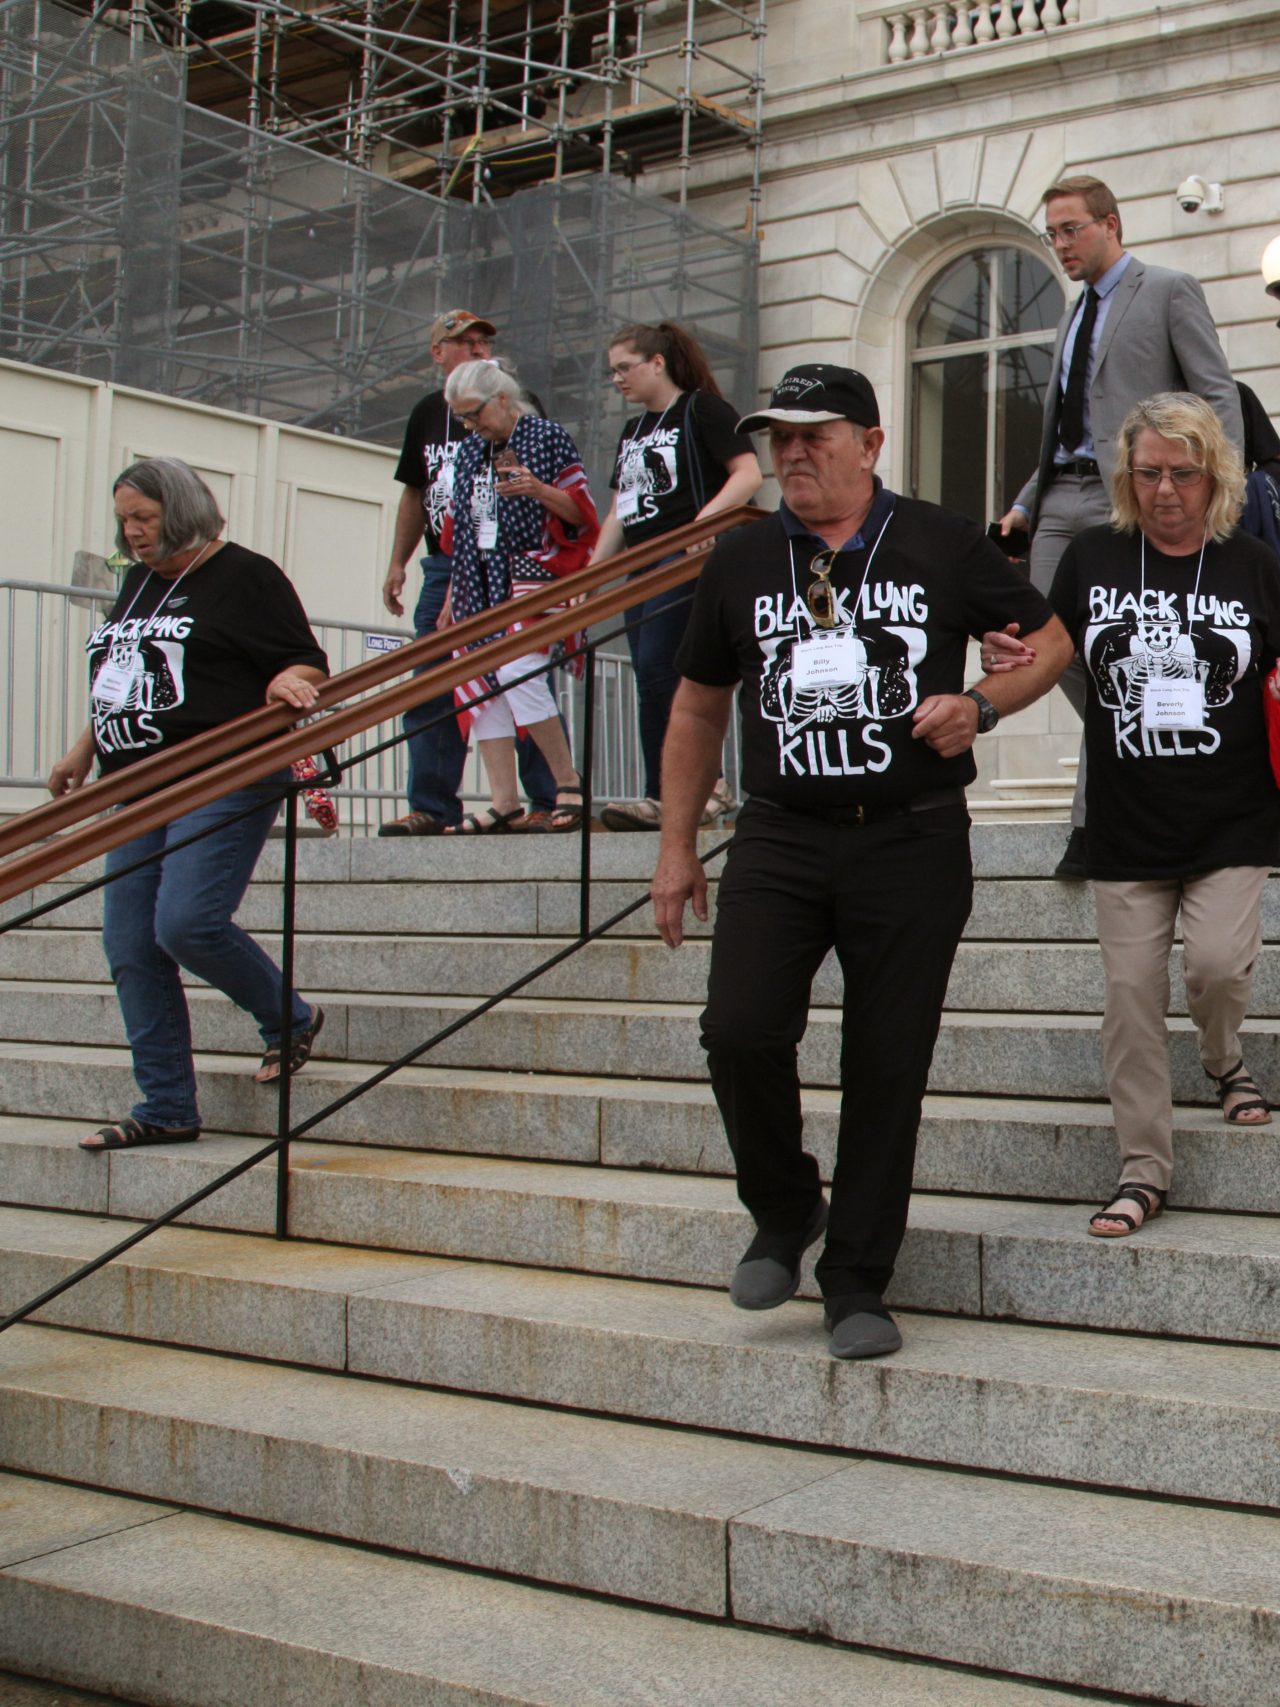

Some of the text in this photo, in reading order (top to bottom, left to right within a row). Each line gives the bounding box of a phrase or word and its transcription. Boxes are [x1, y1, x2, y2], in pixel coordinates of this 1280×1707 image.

[775, 377, 813, 390] TIRED
[755, 581, 929, 638] BLAK LUNG
[1089, 586, 1251, 627] BLACK LUNG
[144, 615, 194, 640] LUNG
[805, 667, 838, 676] Johnson
[813, 658, 830, 666] Billy
[94, 713, 164, 754] KILLS
[777, 722, 892, 776] KILLS
[1113, 711, 1221, 759] KILLS
